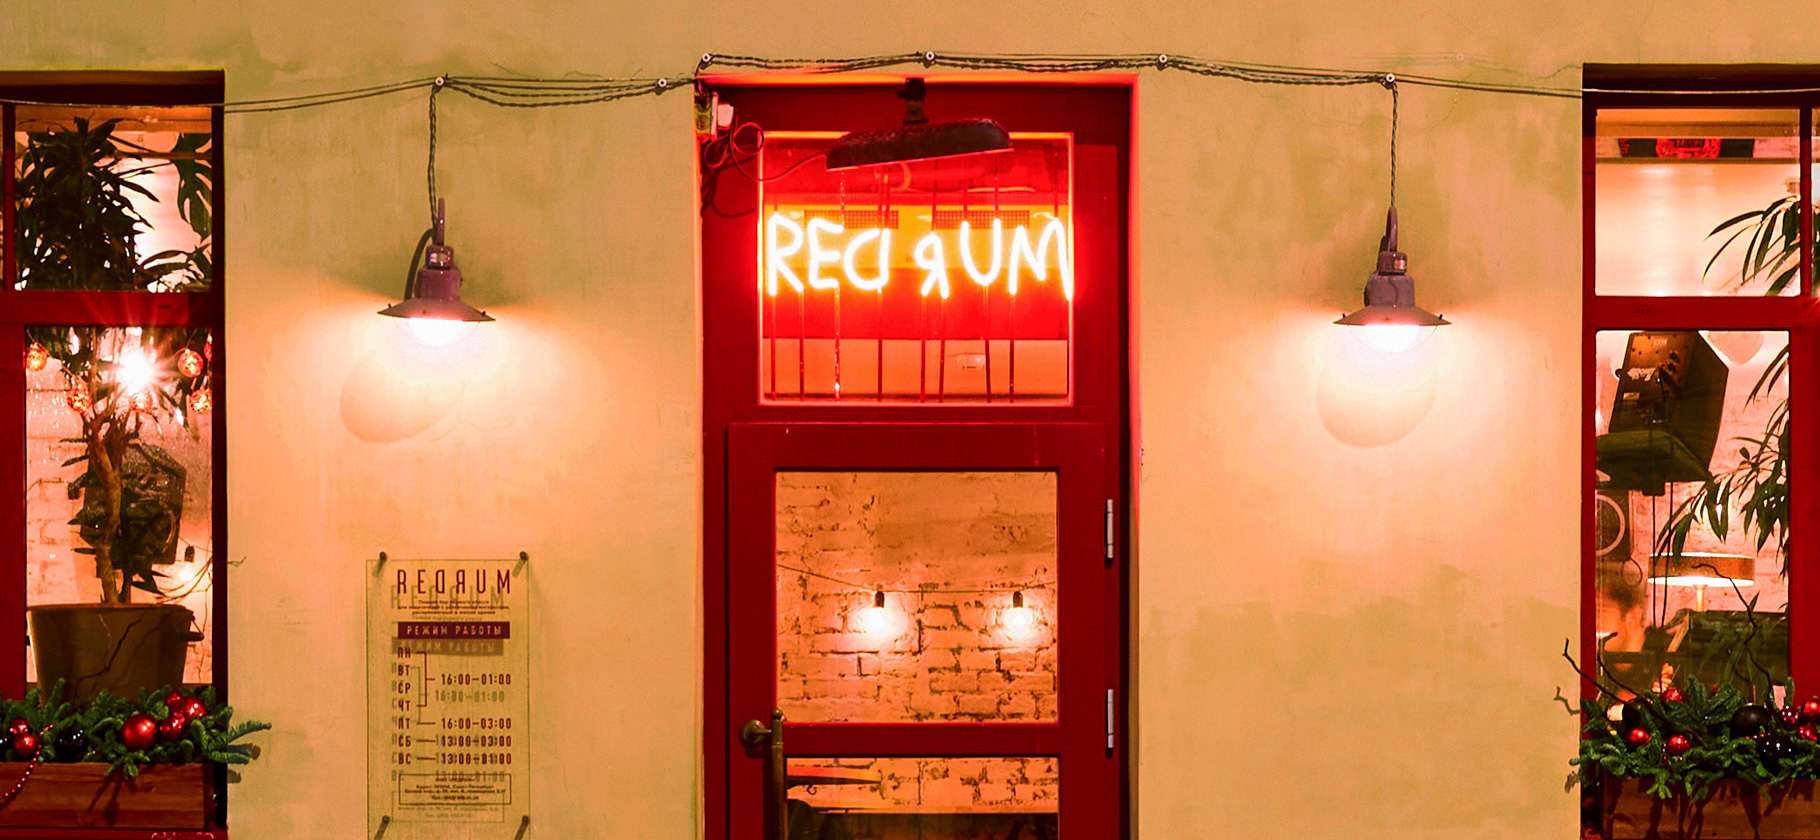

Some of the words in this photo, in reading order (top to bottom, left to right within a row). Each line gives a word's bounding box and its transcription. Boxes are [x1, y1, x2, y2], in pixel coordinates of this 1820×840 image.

[406, 625, 448, 636] РЕЖИМ
[455, 625, 502, 636] РАБОТЫ
[397, 647, 411, 659] ПН
[397, 664, 411, 676] ВТ
[397, 682, 411, 694] СР
[397, 700, 411, 712] ЧТ
[397, 718, 411, 729] ПТ
[397, 735, 412, 747] СБ
[397, 753, 412, 765] ВС
